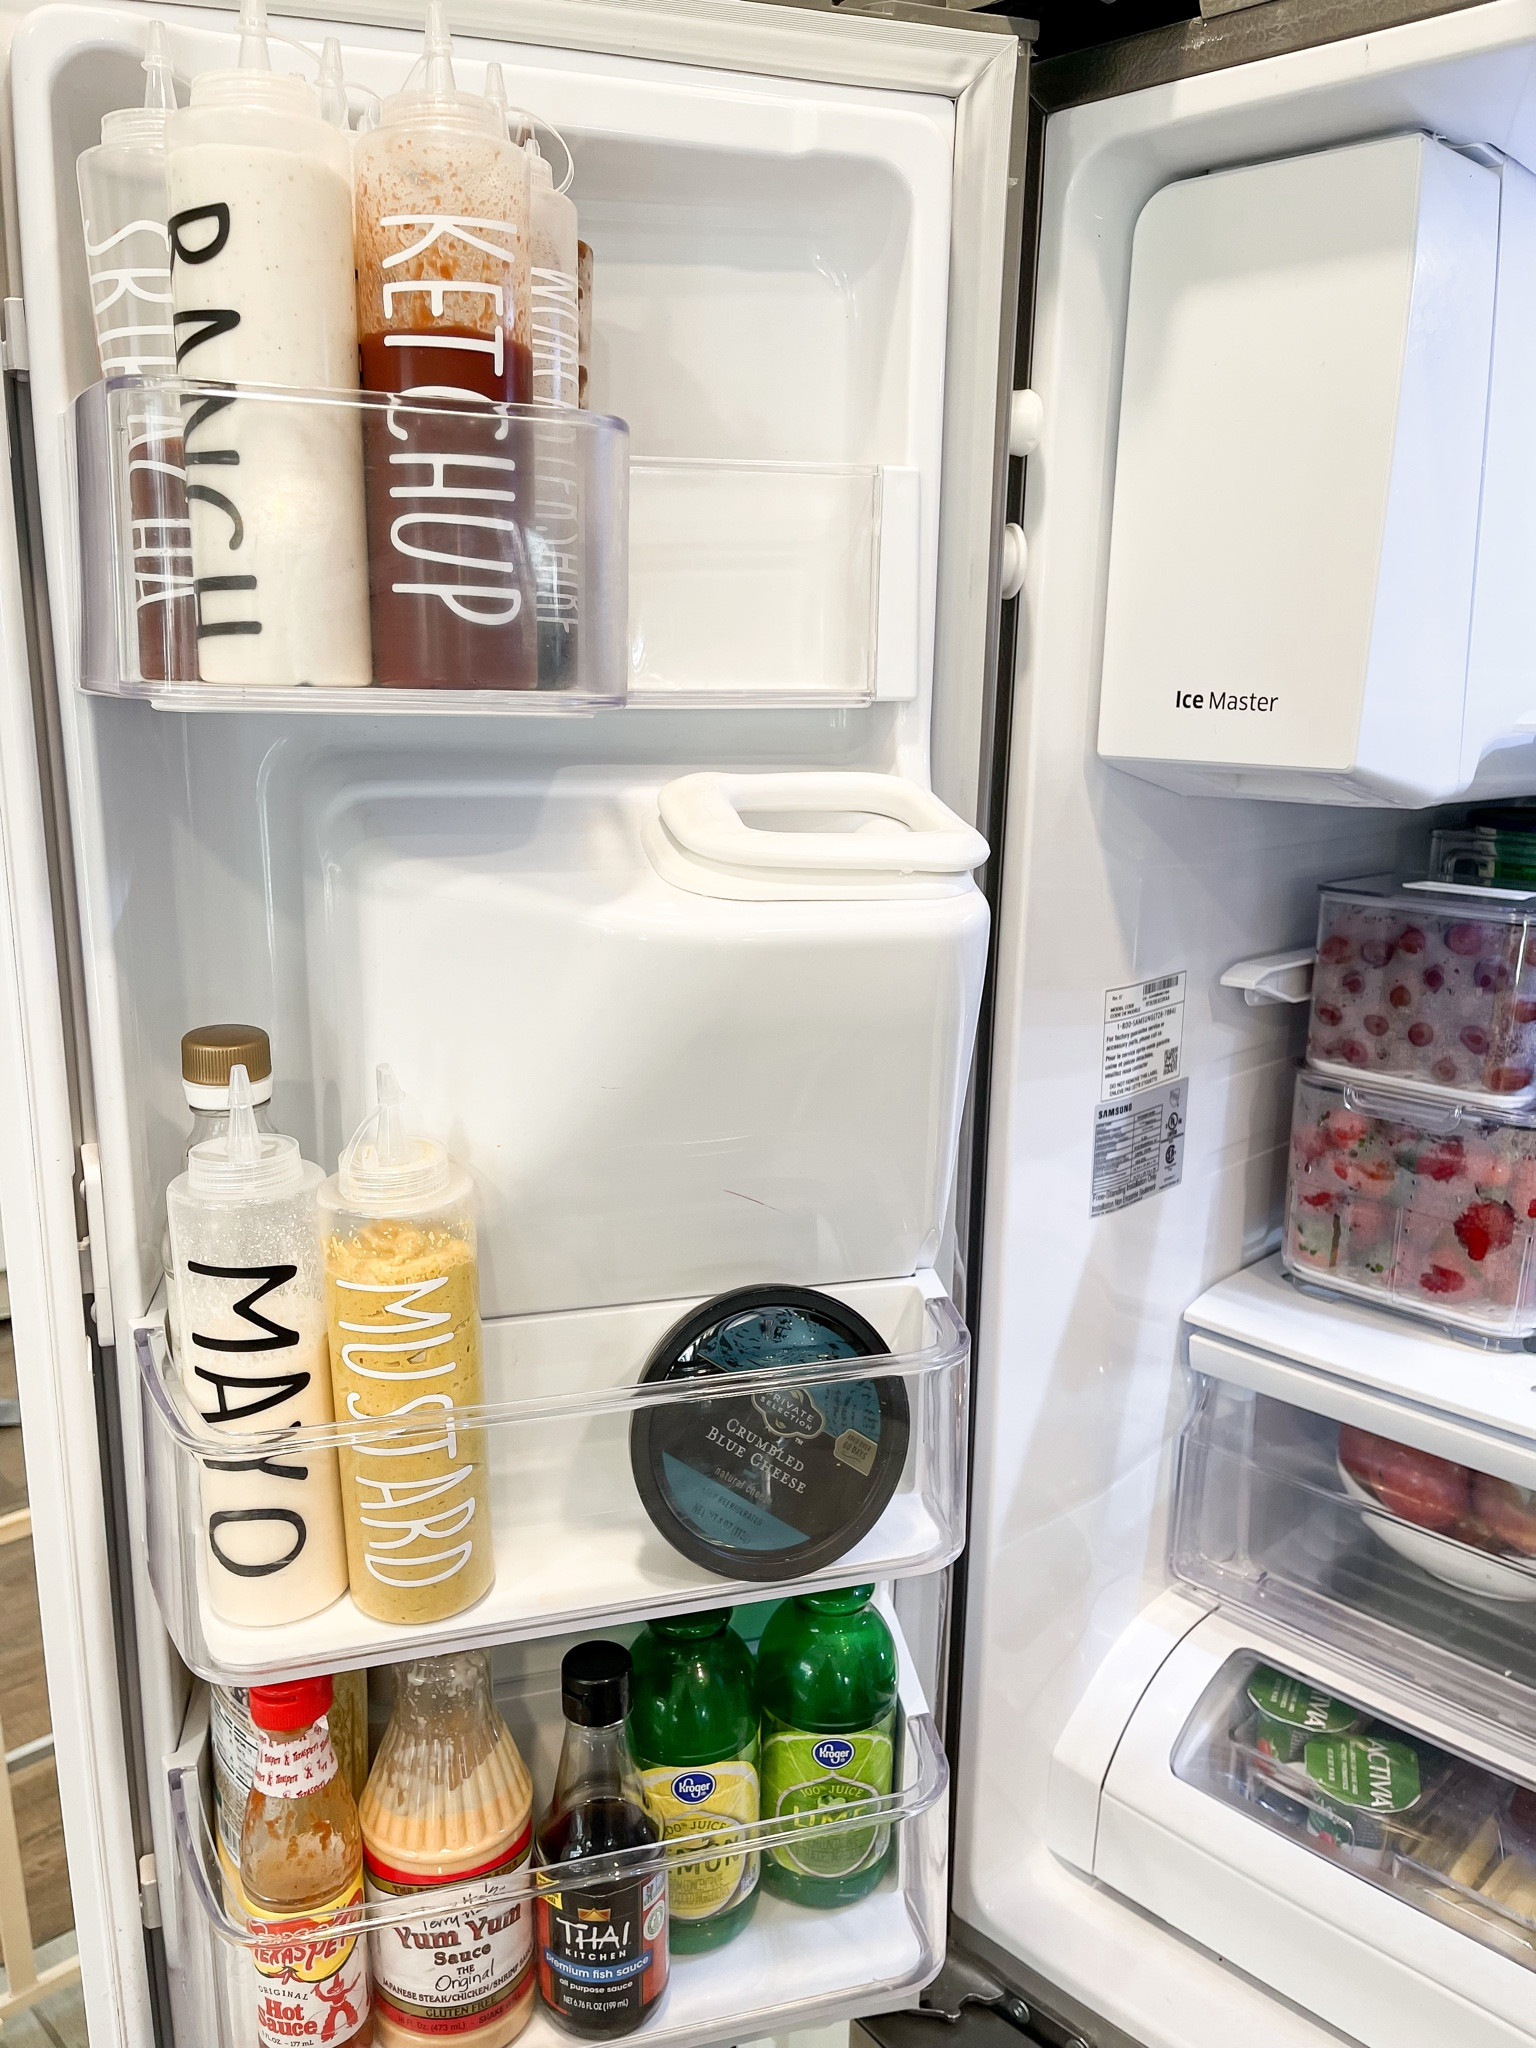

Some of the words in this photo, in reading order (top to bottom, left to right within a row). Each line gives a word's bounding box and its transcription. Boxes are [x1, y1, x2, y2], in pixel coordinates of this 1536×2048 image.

[379, 214, 522, 627] KETCHUP
[1175, 690, 1204, 709] Ice
[1208, 691, 1279, 712] Master
[1098, 1103, 1133, 1120] SAMSUNG
[187, 1260, 311, 1578] MAYO
[760, 1396, 812, 1431] SELECTION
[769, 1392, 815, 1423] RIVATE
[335, 1276, 476, 1588] MUSTARD
[726, 1418, 805, 1473] CRUMBLED
[850, 1444, 868, 1460] DAYS
[705, 1425, 746, 1458] BLUE
[750, 1452, 807, 1495] CHEESE
[714, 1466, 747, 1490] natural
[820, 1744, 850, 1764] Kroger
[1367, 1738, 1394, 1808] ACTIVIA
[679, 1777, 711, 1798] Kroger
[828, 1785, 864, 1798] JUICE
[665, 1822, 688, 1837] 00%
[690, 1820, 727, 1831] JUICE
[667, 1835, 741, 1876] MON
[393, 1926, 462, 1950] Yum
[464, 1903, 522, 1941] Yum
[556, 1916, 631, 1950] THAI
[433, 1943, 492, 1966] Sauce
[545, 1952, 590, 1979] premium
[592, 1968, 613, 1980] fish
[616, 1955, 649, 1977] sauce
[565, 1948, 627, 1961] KITCHEN
[434, 1958, 495, 1993] Original
[456, 1963, 475, 1975] THE
[258, 1985, 309, 2001] ORIGINAL
[382, 1977, 418, 2001] JAPANESE
[559, 1977, 569, 1987] all
[570, 1983, 605, 1995] purpose
[606, 1980, 633, 1993] sauce
[265, 1996, 305, 2021] Hot
[425, 2005, 469, 2018] GLUTEN
[471, 1994, 498, 2013] FREE
[563, 1994, 574, 2006] NET
[574, 1997, 586, 2008] 6.76
[586, 2001, 593, 2010] FL
[594, 2001, 603, 2011] OZ
[258, 2003, 318, 2037] Sauce
[430, 2020, 449, 2032] (473
[450, 2020, 466, 2031] mL)
[479, 2006, 505, 2023] SHAKE
[290, 2040, 301, 2048] 177
[302, 2039, 315, 2047] mL
